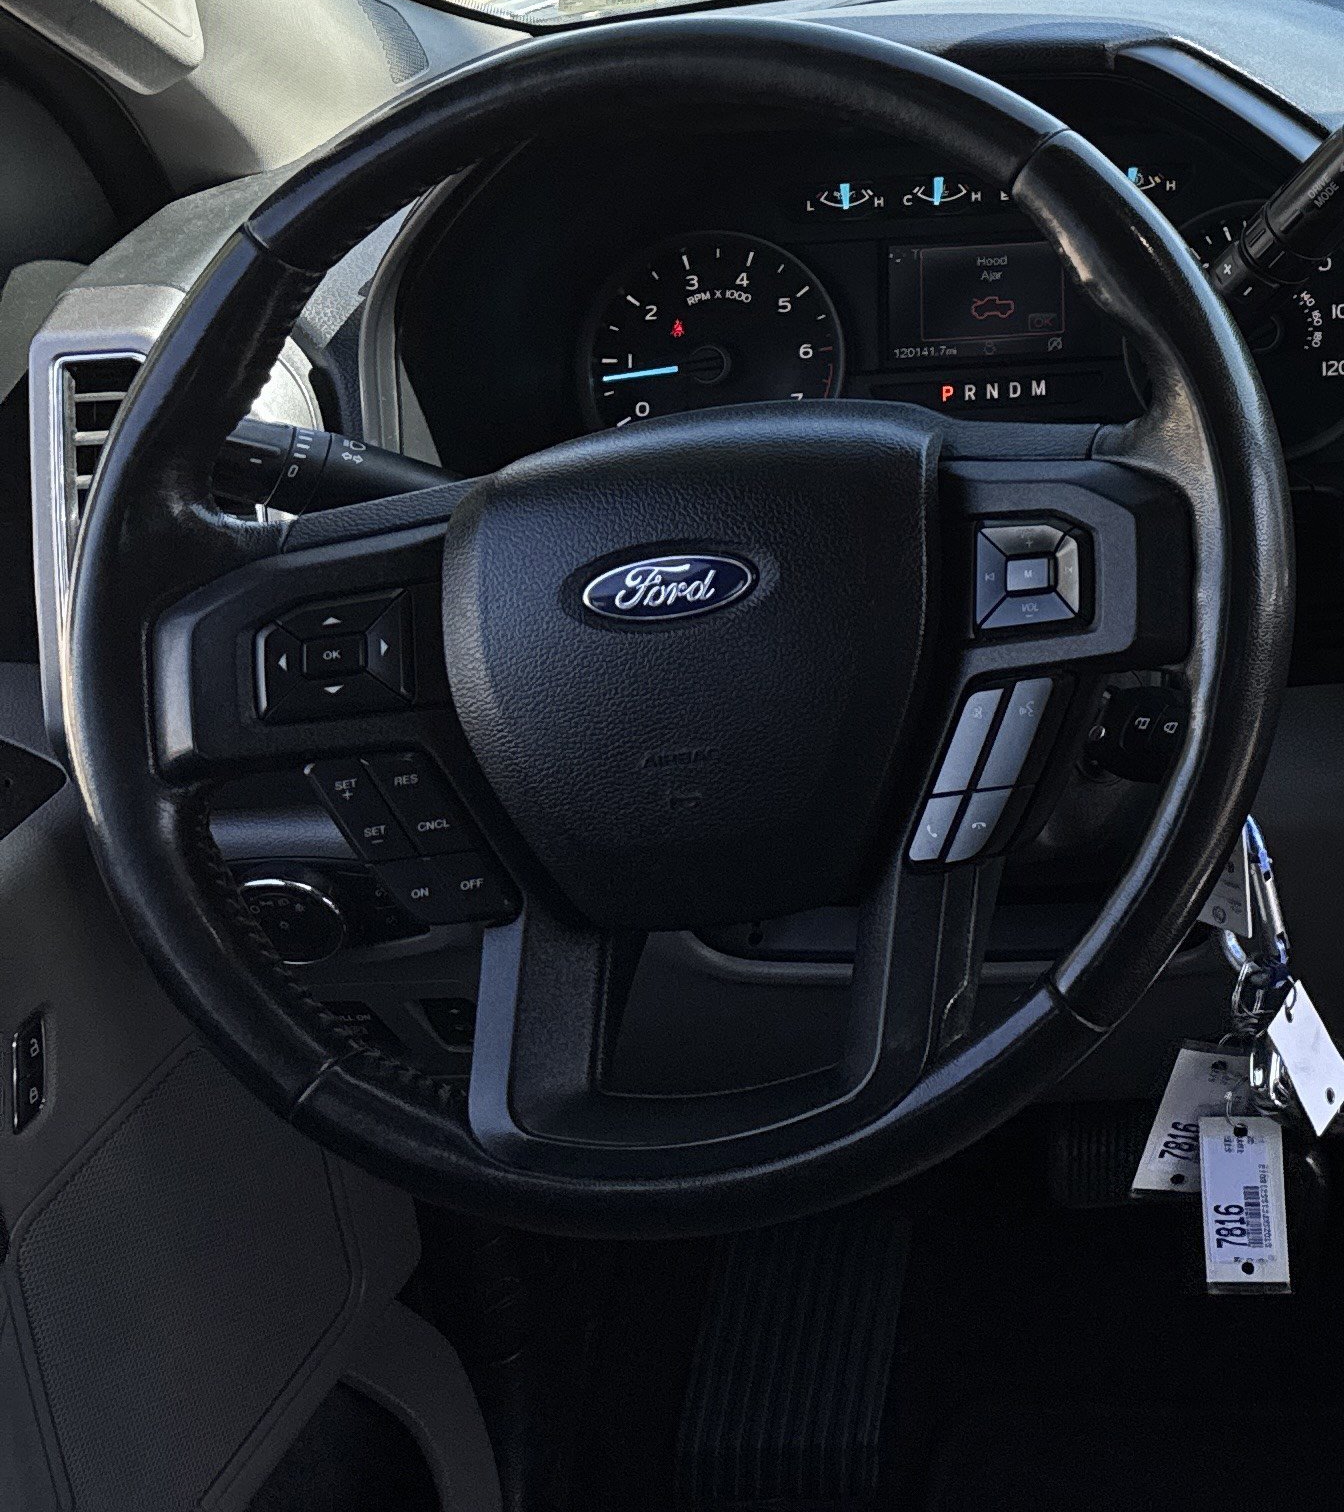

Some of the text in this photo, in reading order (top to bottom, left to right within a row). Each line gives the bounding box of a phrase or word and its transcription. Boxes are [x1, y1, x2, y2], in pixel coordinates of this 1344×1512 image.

[1165, 179, 1177, 192] H
[1307, 173, 1333, 200] DRIVE
[874, 196, 884, 208] H
[903, 194, 913, 206] C
[971, 191, 982, 202] H
[1313, 181, 1340, 209] MODE
[806, 200, 815, 212] L
[976, 255, 1009, 267] Hood
[685, 275, 699, 291] 3
[735, 272, 749, 288] 4
[980, 270, 1003, 283] Ajar
[686, 289, 752, 306] RPM X 1000
[1300, 290, 1316, 308] 140
[777, 297, 792, 313] 5
[644, 305, 658, 321] 2
[1311, 309, 1323, 326] 160
[1033, 316, 1054, 328] OK
[799, 343, 813, 359] 6
[627, 353, 633, 369] 1
[941, 379, 1046, 402] P R N D M
[635, 401, 650, 417] 0
[1023, 569, 1033, 578] M
[614, 563, 717, 610] Ford
[1021, 602, 1039, 613] VOL
[322, 649, 341, 660] OK
[334, 777, 357, 791] SET
[393, 773, 419, 787] RES
[363, 824, 387, 838] SET
[417, 818, 450, 832] CNCL
[460, 877, 484, 891] OFF
[410, 887, 430, 899] ON
[1158, 1121, 1200, 1162] 7816
[1213, 1204, 1250, 1249] 7816
